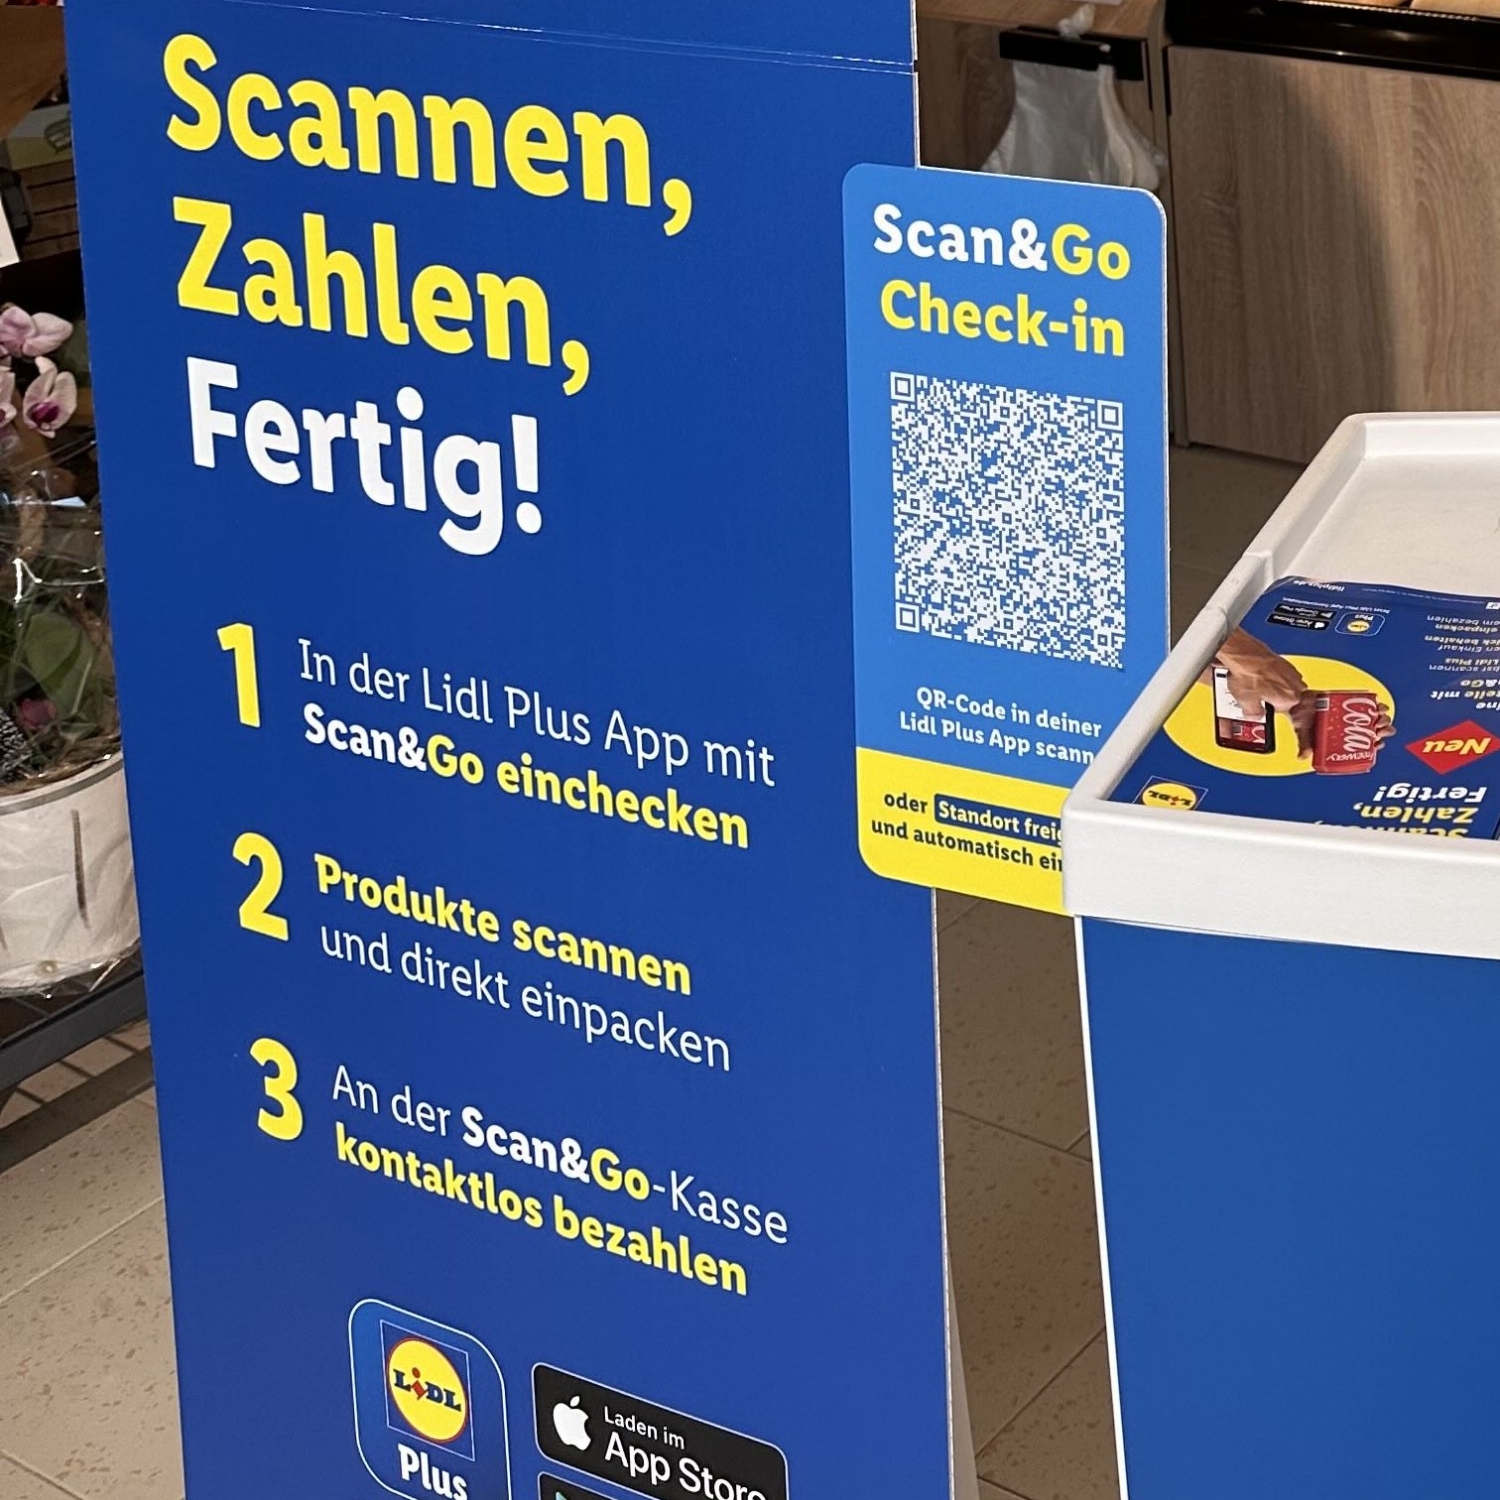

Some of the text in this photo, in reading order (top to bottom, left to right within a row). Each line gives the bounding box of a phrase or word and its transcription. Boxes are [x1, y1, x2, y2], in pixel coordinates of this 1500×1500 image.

[163, 33, 693, 237] Scannen,
[873, 203, 1131, 280] Scan&Go
[172, 195, 590, 396] Zahlen,
[880, 279, 1125, 357] Check-in
[186, 355, 542, 556] Fertig!
[216, 622, 261, 728] 1
[298, 638, 776, 787] In der Lidl Plus App mit
[916, 686, 1102, 739] QR-Code in deiner
[1430, 690, 1460, 700] mit
[302, 702, 749, 849] Scan&Go einchecken
[900, 711, 1095, 766] Lidl Plus App scann
[1422, 737, 1492, 755] Neu
[884, 793, 928, 815] oder
[938, 801, 1020, 834] Standort
[1353, 803, 1478, 823] Zahlen,
[1376, 783, 1488, 803] Fertig!
[871, 820, 908, 840] und
[914, 828, 1034, 867] automatisch
[231, 831, 289, 941] 2
[313, 852, 691, 996] Produkte scannen
[321, 924, 730, 1072] und direkt einpacken
[249, 1036, 303, 1141] 3
[332, 1064, 788, 1244] An der Scan&Go-Kasse
[335, 1121, 747, 1296] kontaktlos bezahlen
[604, 1406, 685, 1450] Laden im
[605, 1431, 671, 1485] App
[398, 1443, 468, 1500] Plus
